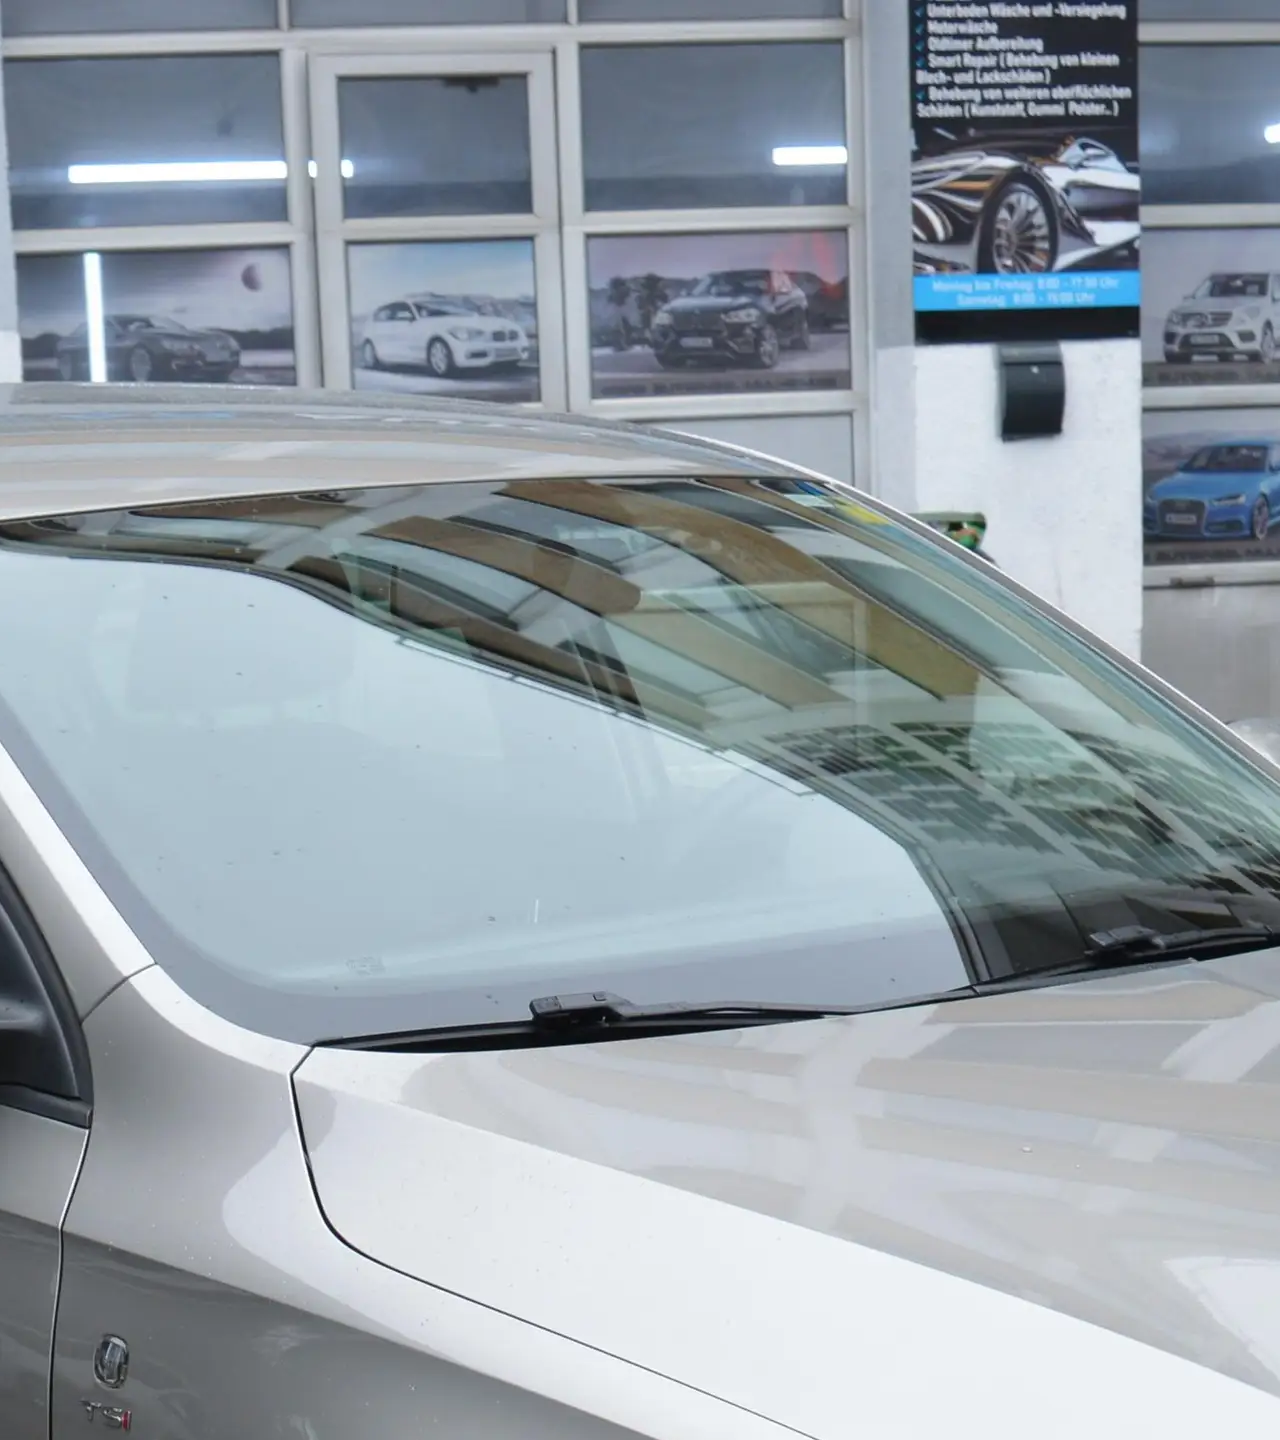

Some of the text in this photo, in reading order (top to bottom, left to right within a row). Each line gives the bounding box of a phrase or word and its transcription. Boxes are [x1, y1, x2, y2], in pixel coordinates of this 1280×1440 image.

[1032, 2, 1052, 17] und
[928, 53, 961, 67] Smart
[953, 70, 974, 83] und
